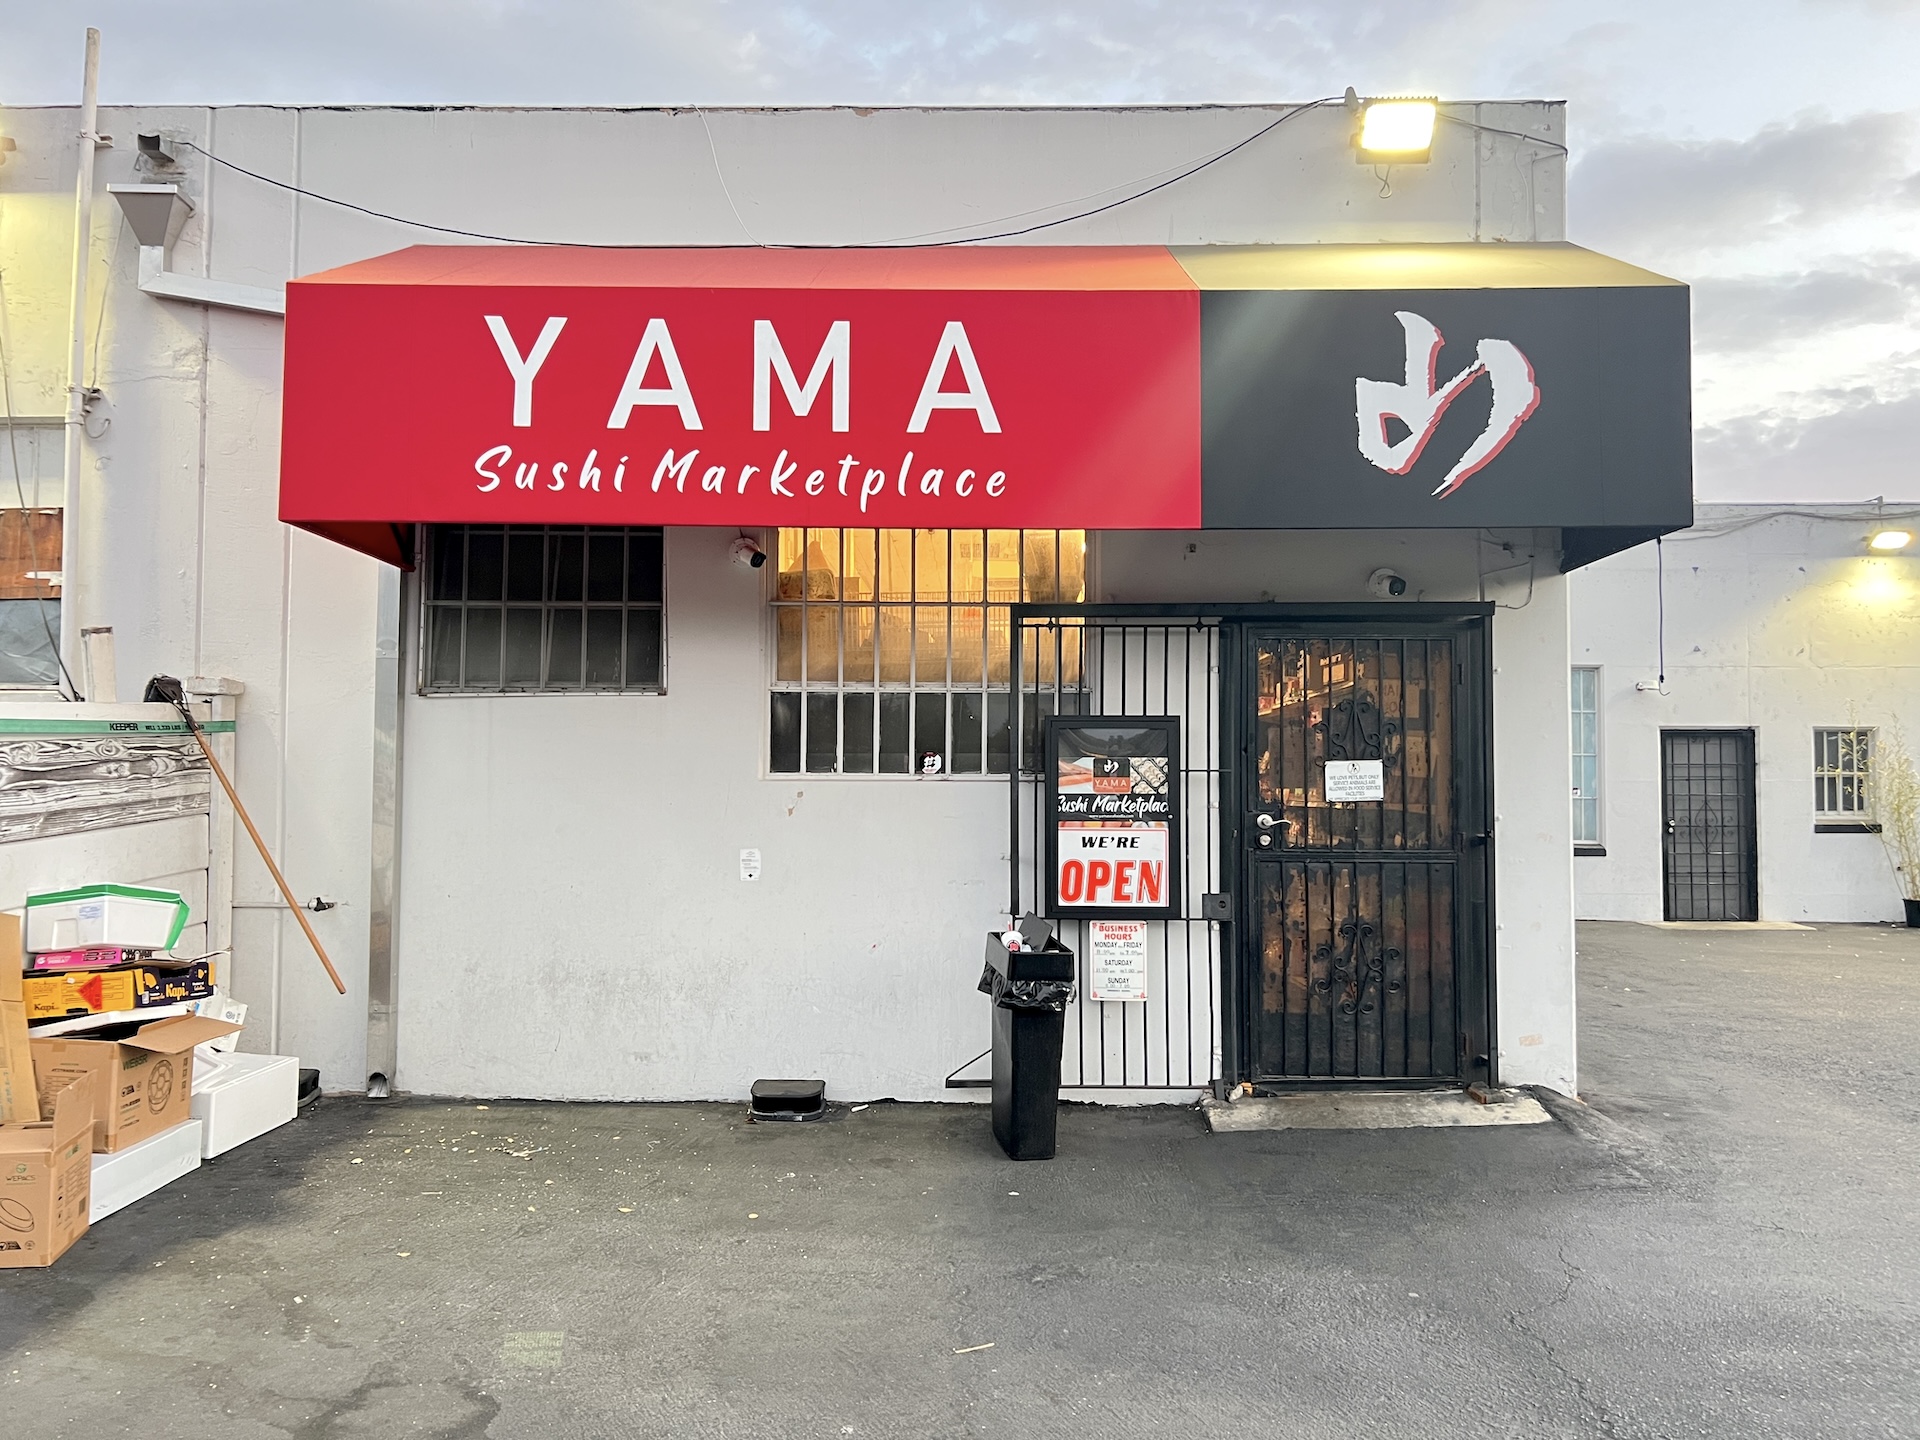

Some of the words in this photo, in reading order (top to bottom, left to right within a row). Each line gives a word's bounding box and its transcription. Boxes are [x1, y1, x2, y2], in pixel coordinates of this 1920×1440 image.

[483, 315, 1003, 434] YAMA
[474, 444, 627, 495] Sushi
[651, 448, 1007, 514] Marketplace
[109, 722, 139, 731] KEEPER
[1094, 779, 1128, 787] YAMA
[1060, 858, 1163, 904] OPEN
[165, 982, 186, 1001] Kapi
[33, 1002, 55, 1012] Kapi
